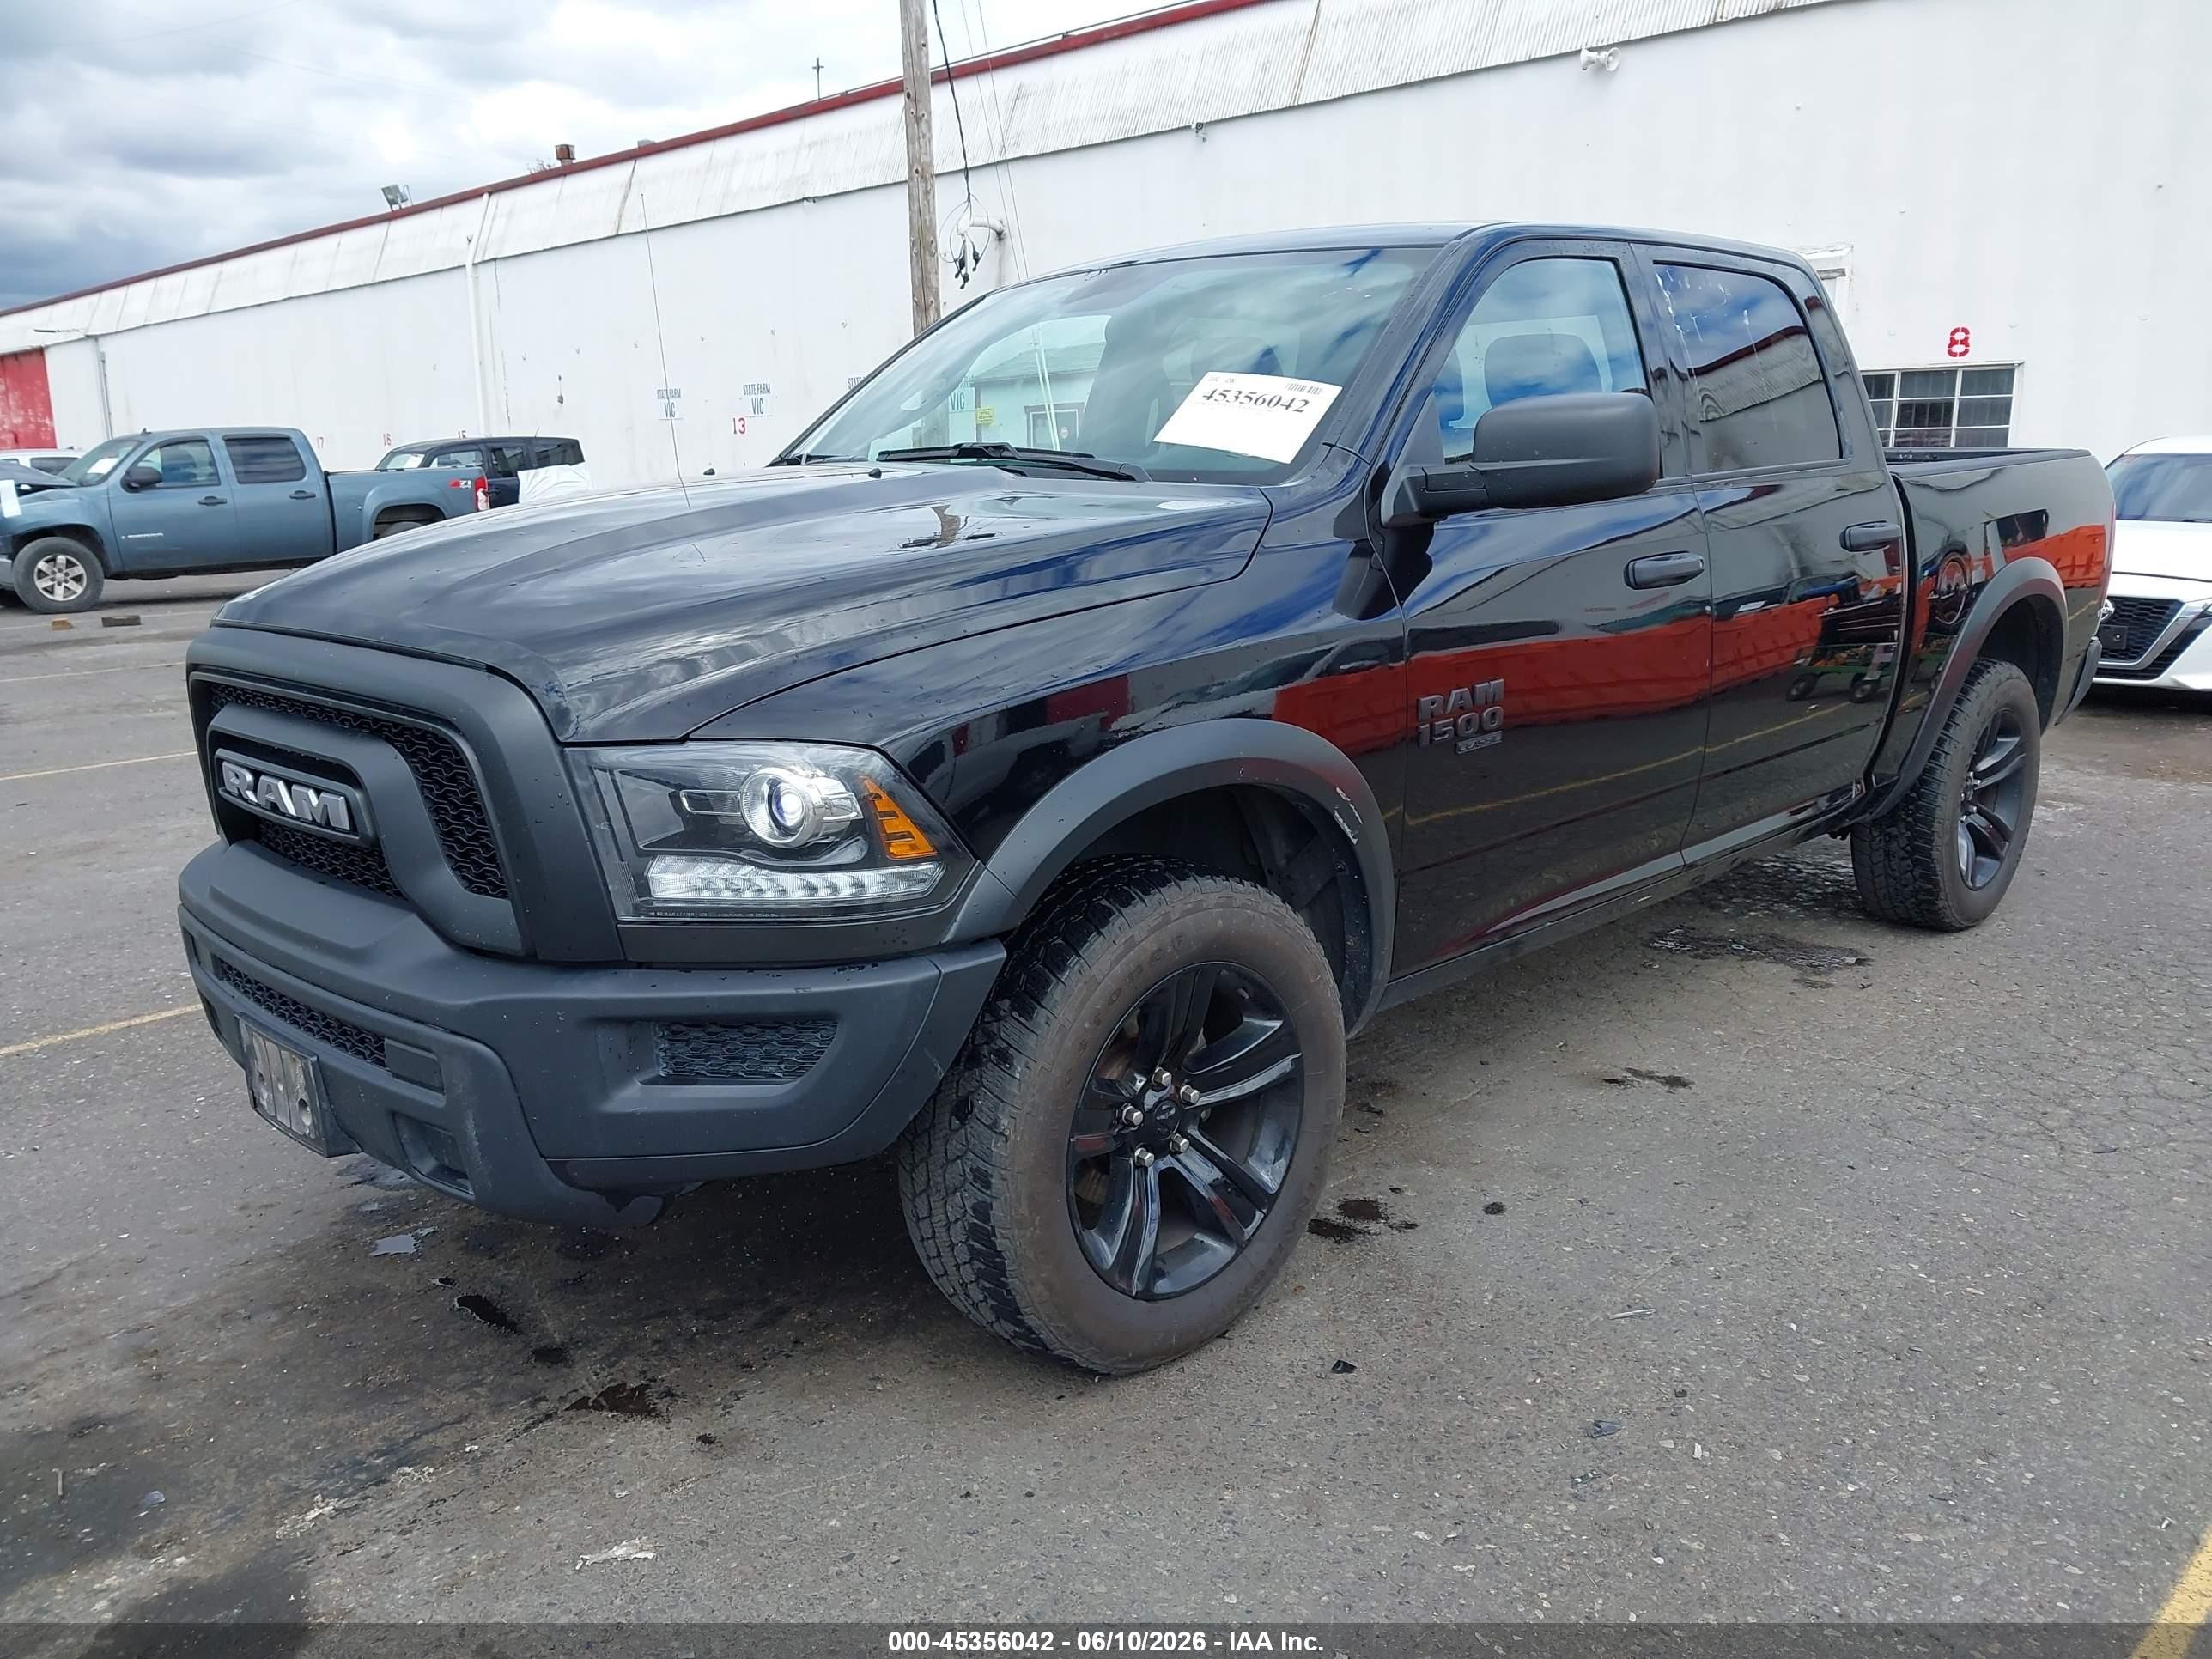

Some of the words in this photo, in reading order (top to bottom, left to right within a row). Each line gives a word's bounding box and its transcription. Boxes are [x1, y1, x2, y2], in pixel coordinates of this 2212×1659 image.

[1947, 326, 1971, 358] 8
[669, 388, 682, 399] FARM
[743, 383, 757, 396] STATE
[757, 382, 771, 395] FARM
[751, 398, 764, 415] VIC
[950, 392, 965, 411] VIC
[1202, 388, 1310, 413] 45356042
[664, 402, 676, 418] VIC
[732, 417, 746, 434] 13
[316, 436, 325, 449] 17
[382, 433, 392, 447] 16
[1416, 678, 1504, 723] RAM
[1417, 706, 1504, 748] 1500
[222, 760, 351, 832] RAM
